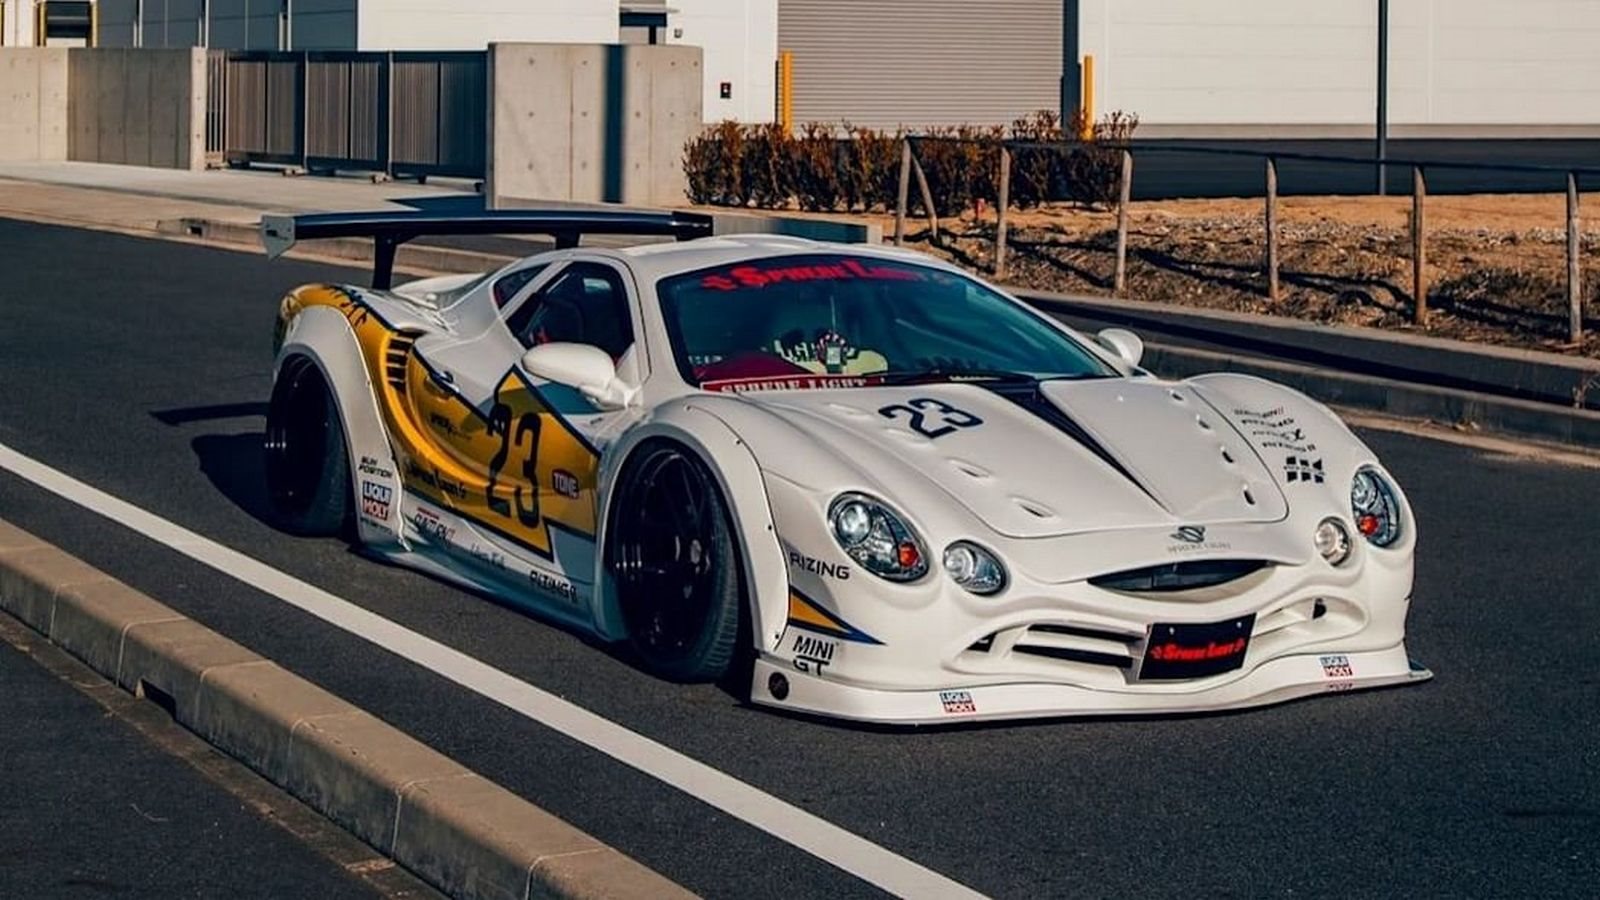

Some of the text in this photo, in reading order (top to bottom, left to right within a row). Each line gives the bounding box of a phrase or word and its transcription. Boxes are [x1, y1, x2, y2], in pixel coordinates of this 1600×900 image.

[878, 398, 983, 439] 23
[486, 402, 541, 529] 23
[790, 552, 850, 580] RIZING
[793, 635, 834, 660] MINI
[793, 655, 830, 676] GT
